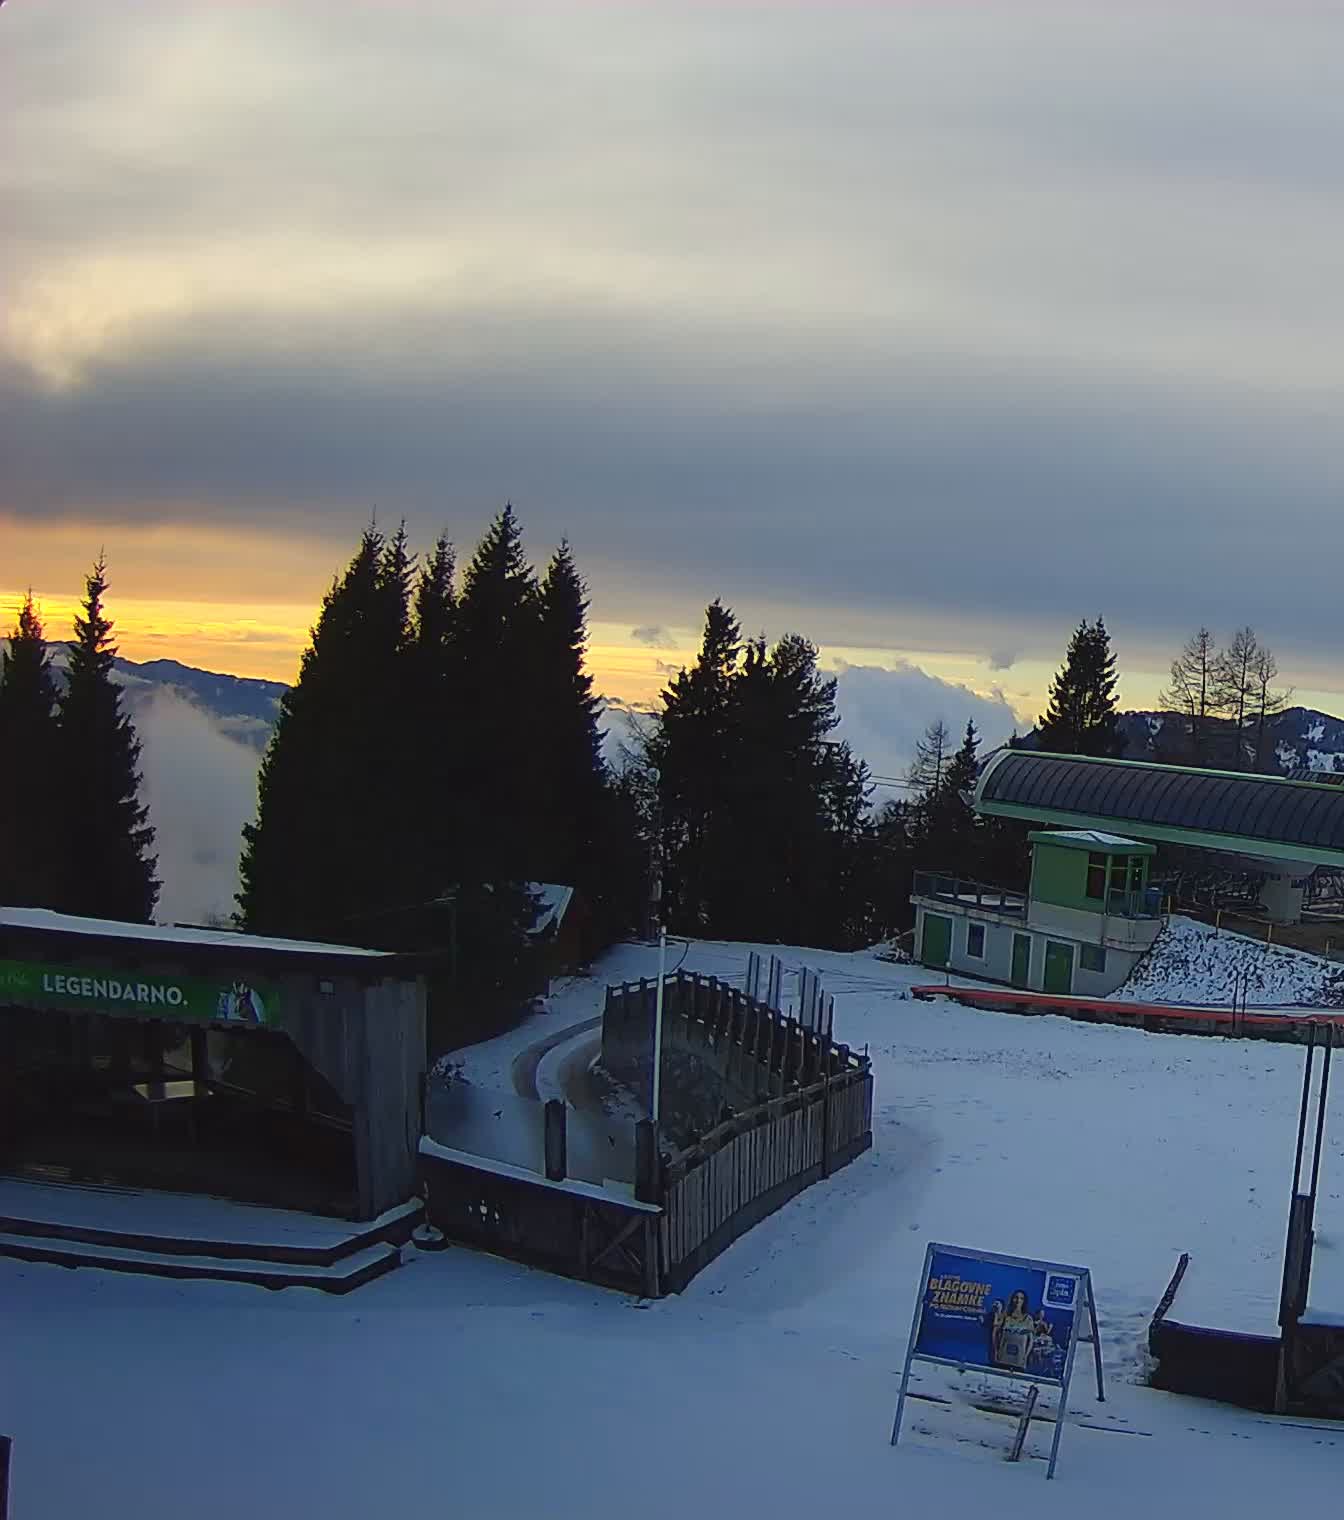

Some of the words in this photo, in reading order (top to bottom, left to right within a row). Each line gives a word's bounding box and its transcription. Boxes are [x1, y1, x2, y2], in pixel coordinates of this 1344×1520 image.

[43, 974, 188, 1006] LEGENDARNO.
[929, 1278, 992, 1296] BLAGOVNE
[932, 1291, 984, 1306] ZNAMKE
